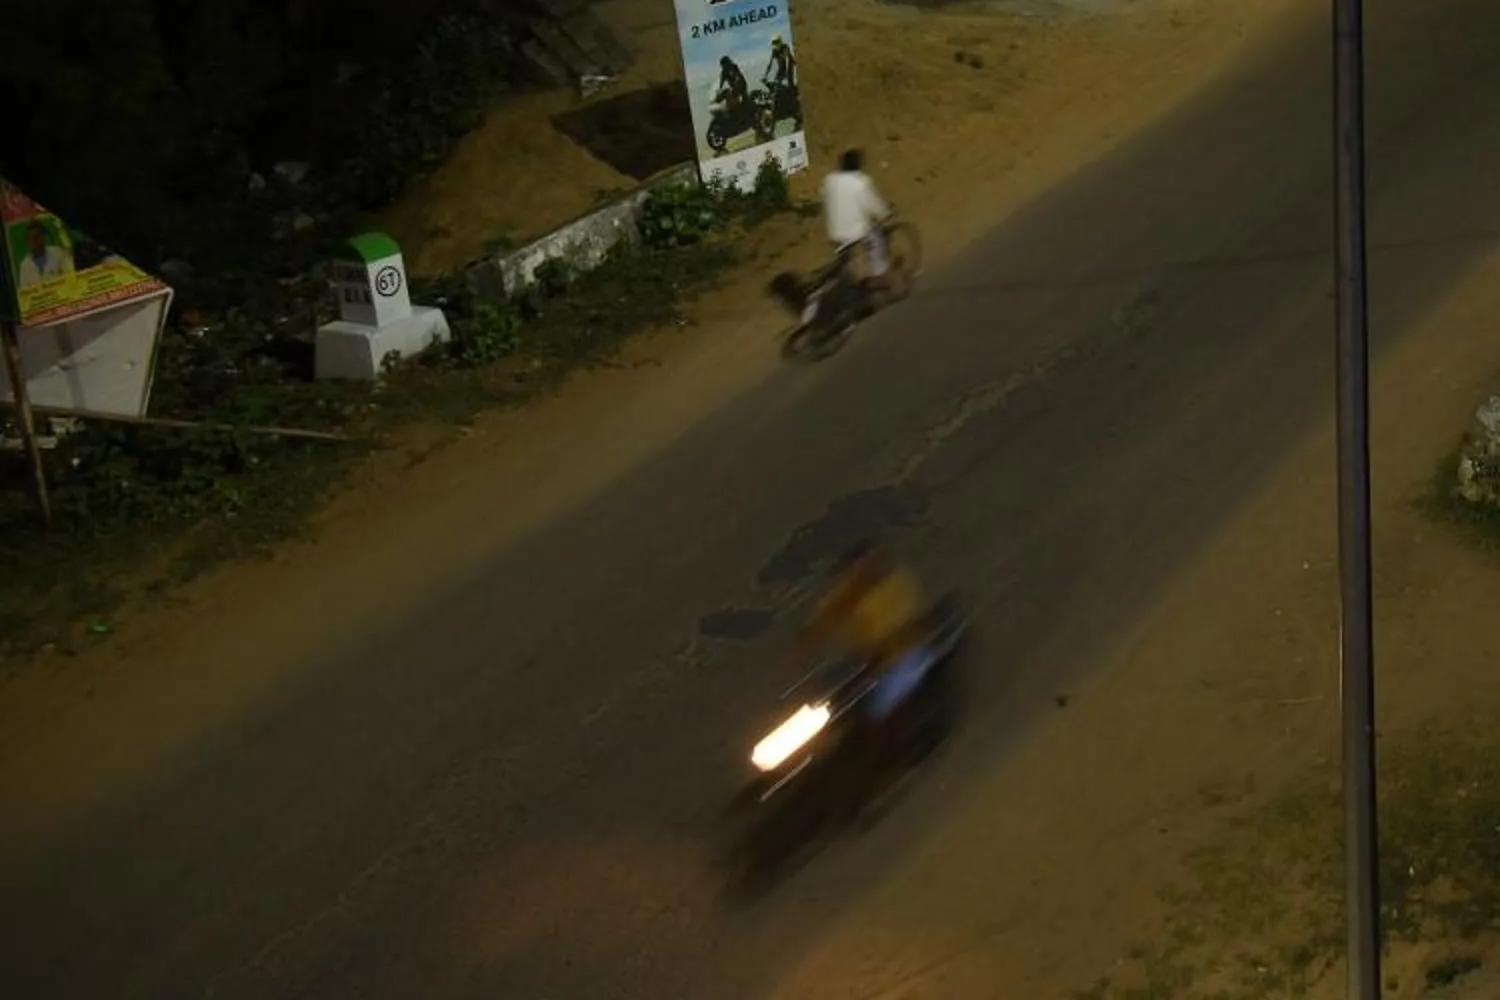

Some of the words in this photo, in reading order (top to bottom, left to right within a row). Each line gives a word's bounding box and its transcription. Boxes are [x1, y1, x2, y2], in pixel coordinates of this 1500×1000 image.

[691, 24, 701, 39] 2
[703, 18, 726, 35] KM
[728, 5, 777, 28] AHEAD
